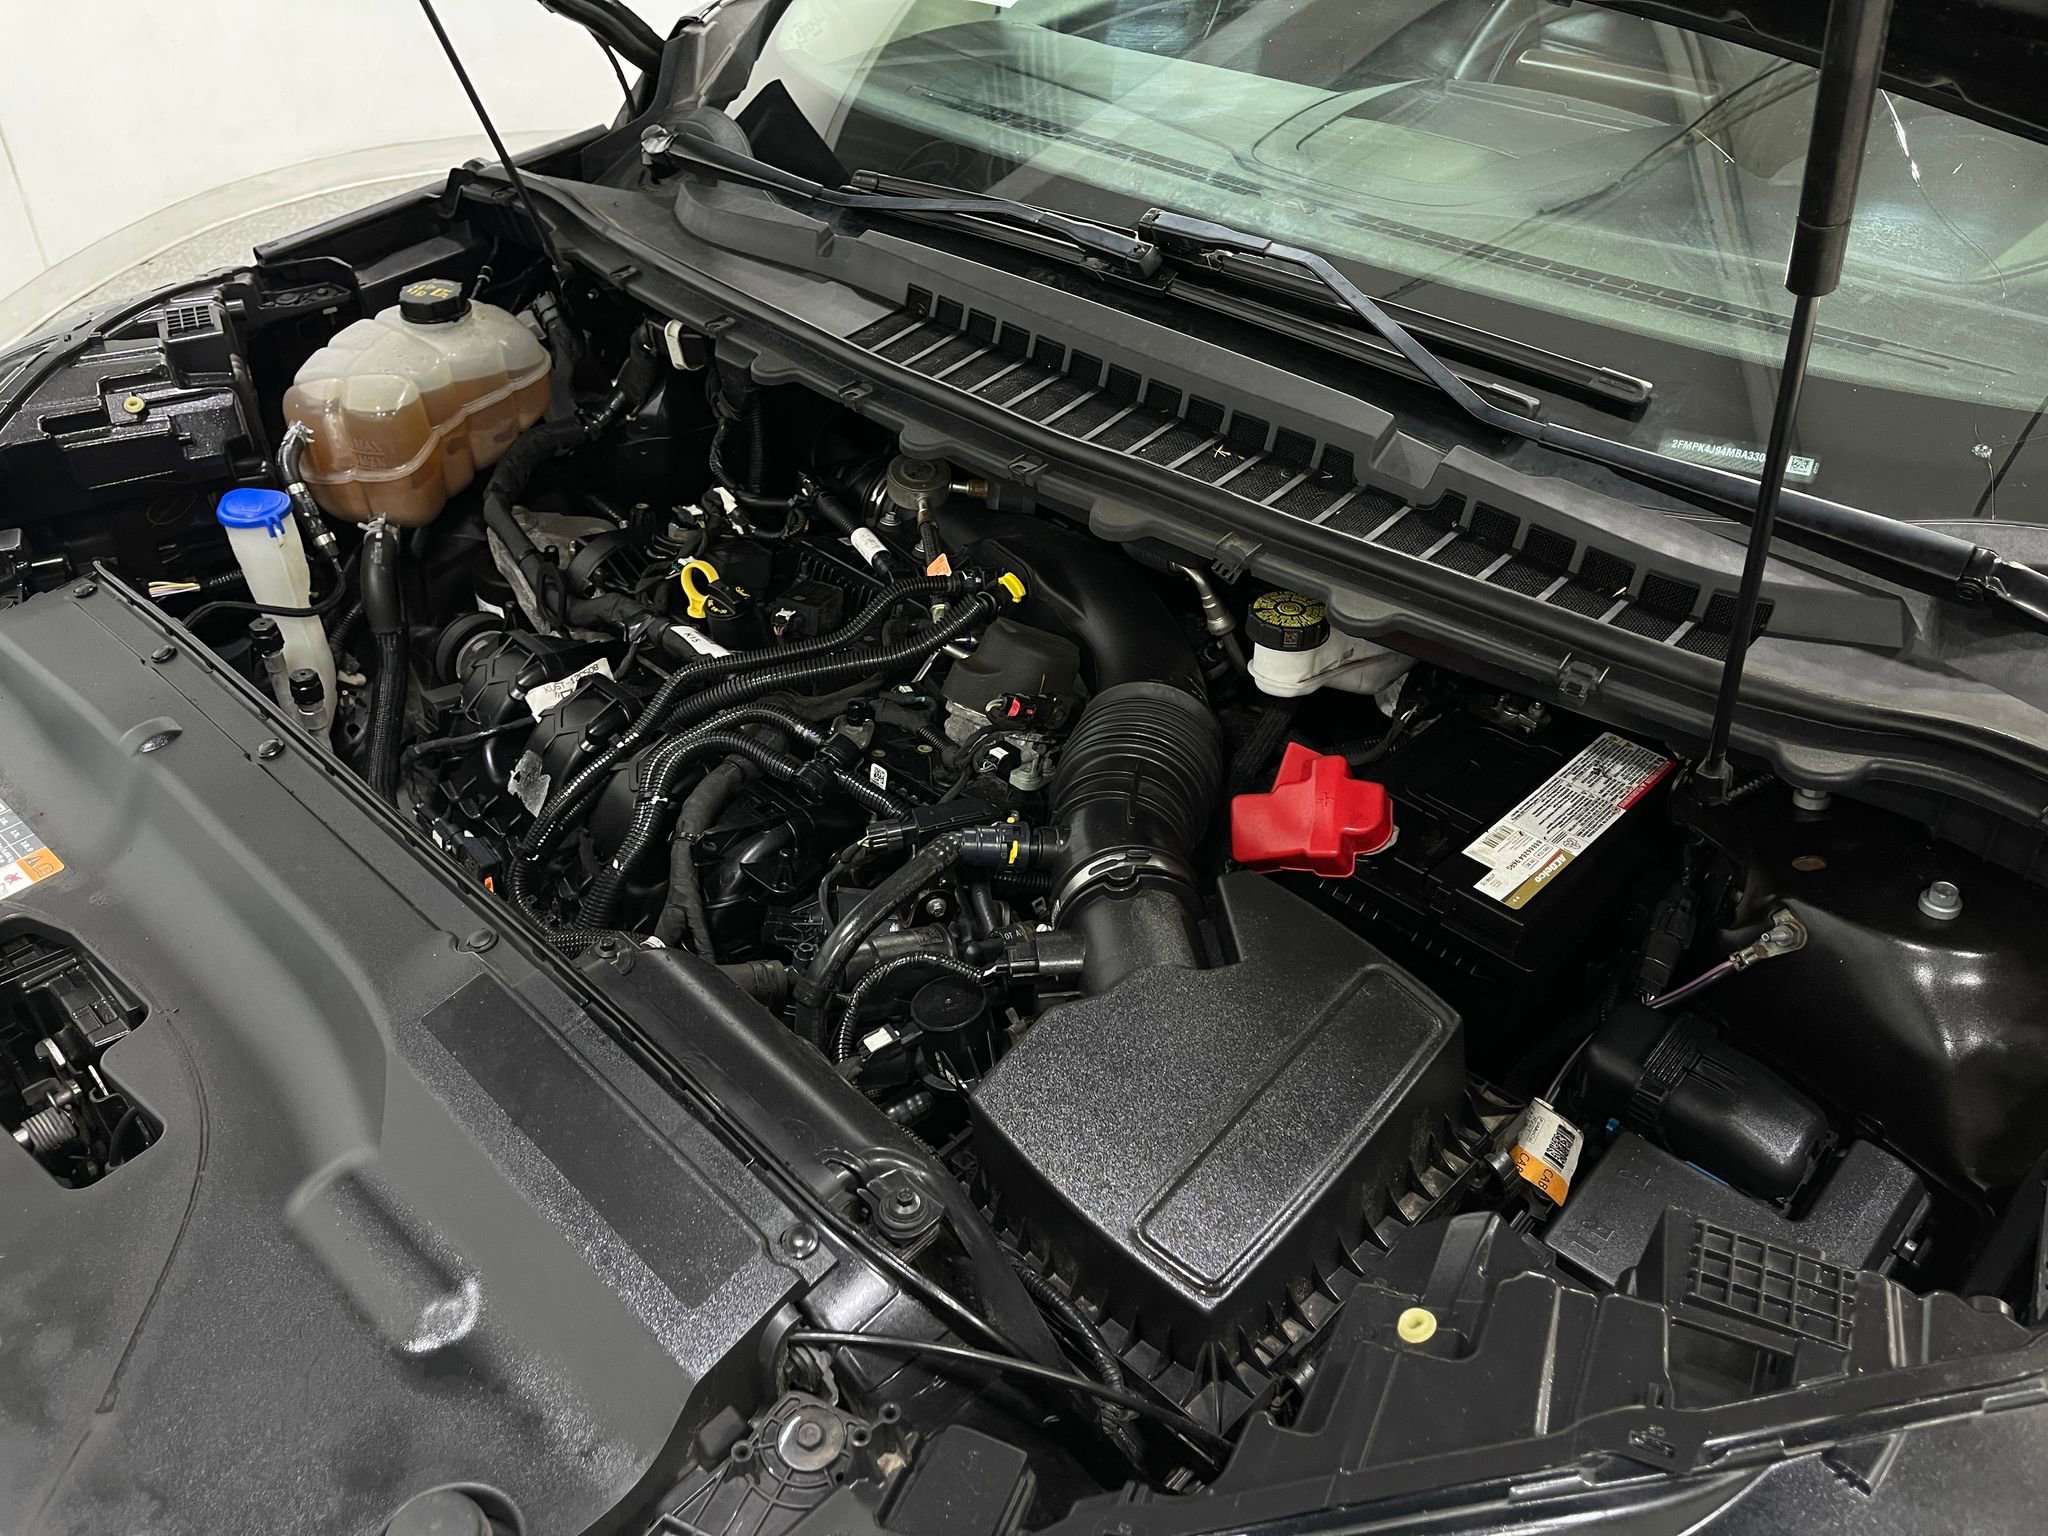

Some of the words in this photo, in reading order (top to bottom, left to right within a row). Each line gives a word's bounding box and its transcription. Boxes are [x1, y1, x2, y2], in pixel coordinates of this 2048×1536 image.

[1671, 439, 1766, 462] 2FMPK4J94MBA330
[1534, 853, 1567, 884] ACDelco
[1538, 1168, 1553, 1190] CAB
